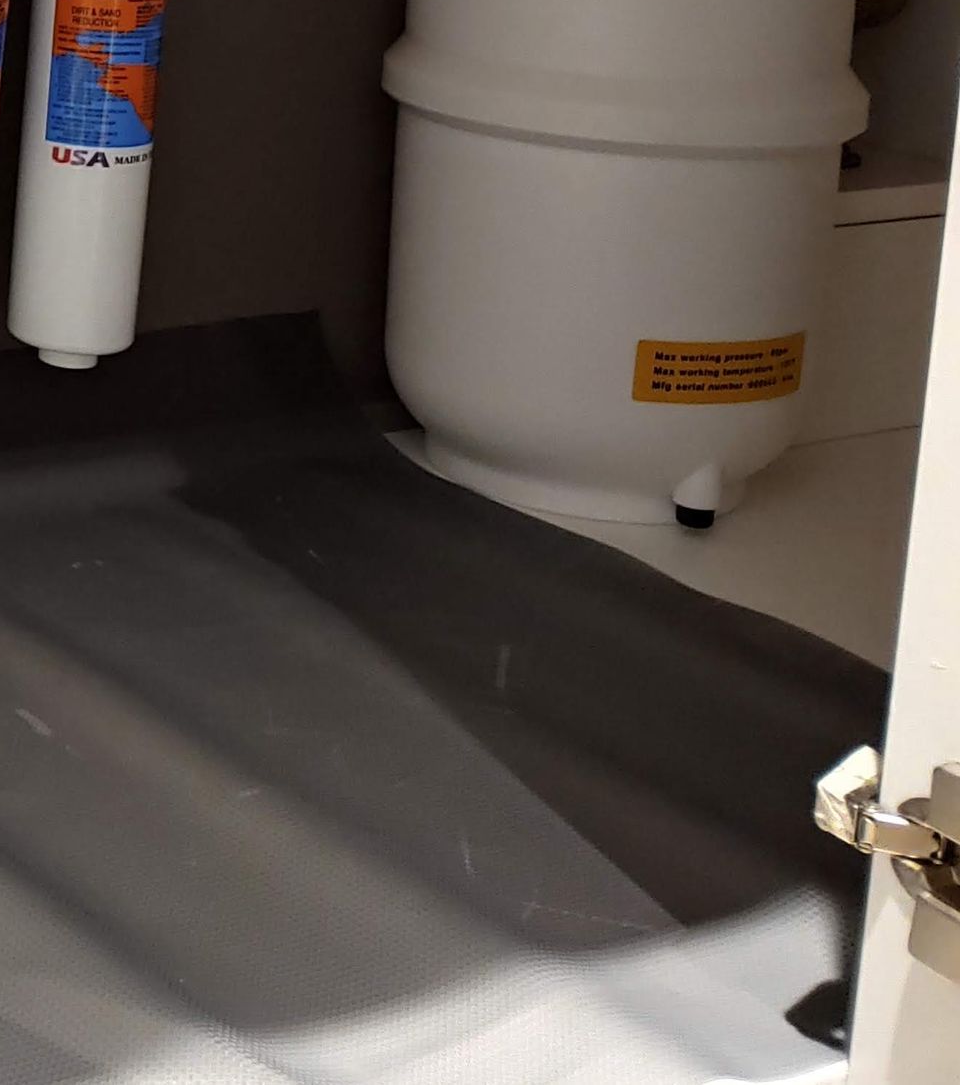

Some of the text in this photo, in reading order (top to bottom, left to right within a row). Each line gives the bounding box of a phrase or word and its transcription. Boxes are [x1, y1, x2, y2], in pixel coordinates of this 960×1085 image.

[71, 6, 121, 17] DIRT & SAND
[72, 15, 119, 27] REDUCTION
[52, 147, 110, 168] USA
[114, 154, 139, 165] MADE
[654, 351, 676, 361] Max
[680, 352, 721, 363] working
[723, 351, 764, 363] pressure
[653, 365, 773, 378] Max working temperature
[652, 380, 672, 392] Mfg
[675, 382, 705, 391] serial
[708, 381, 743, 391] number
